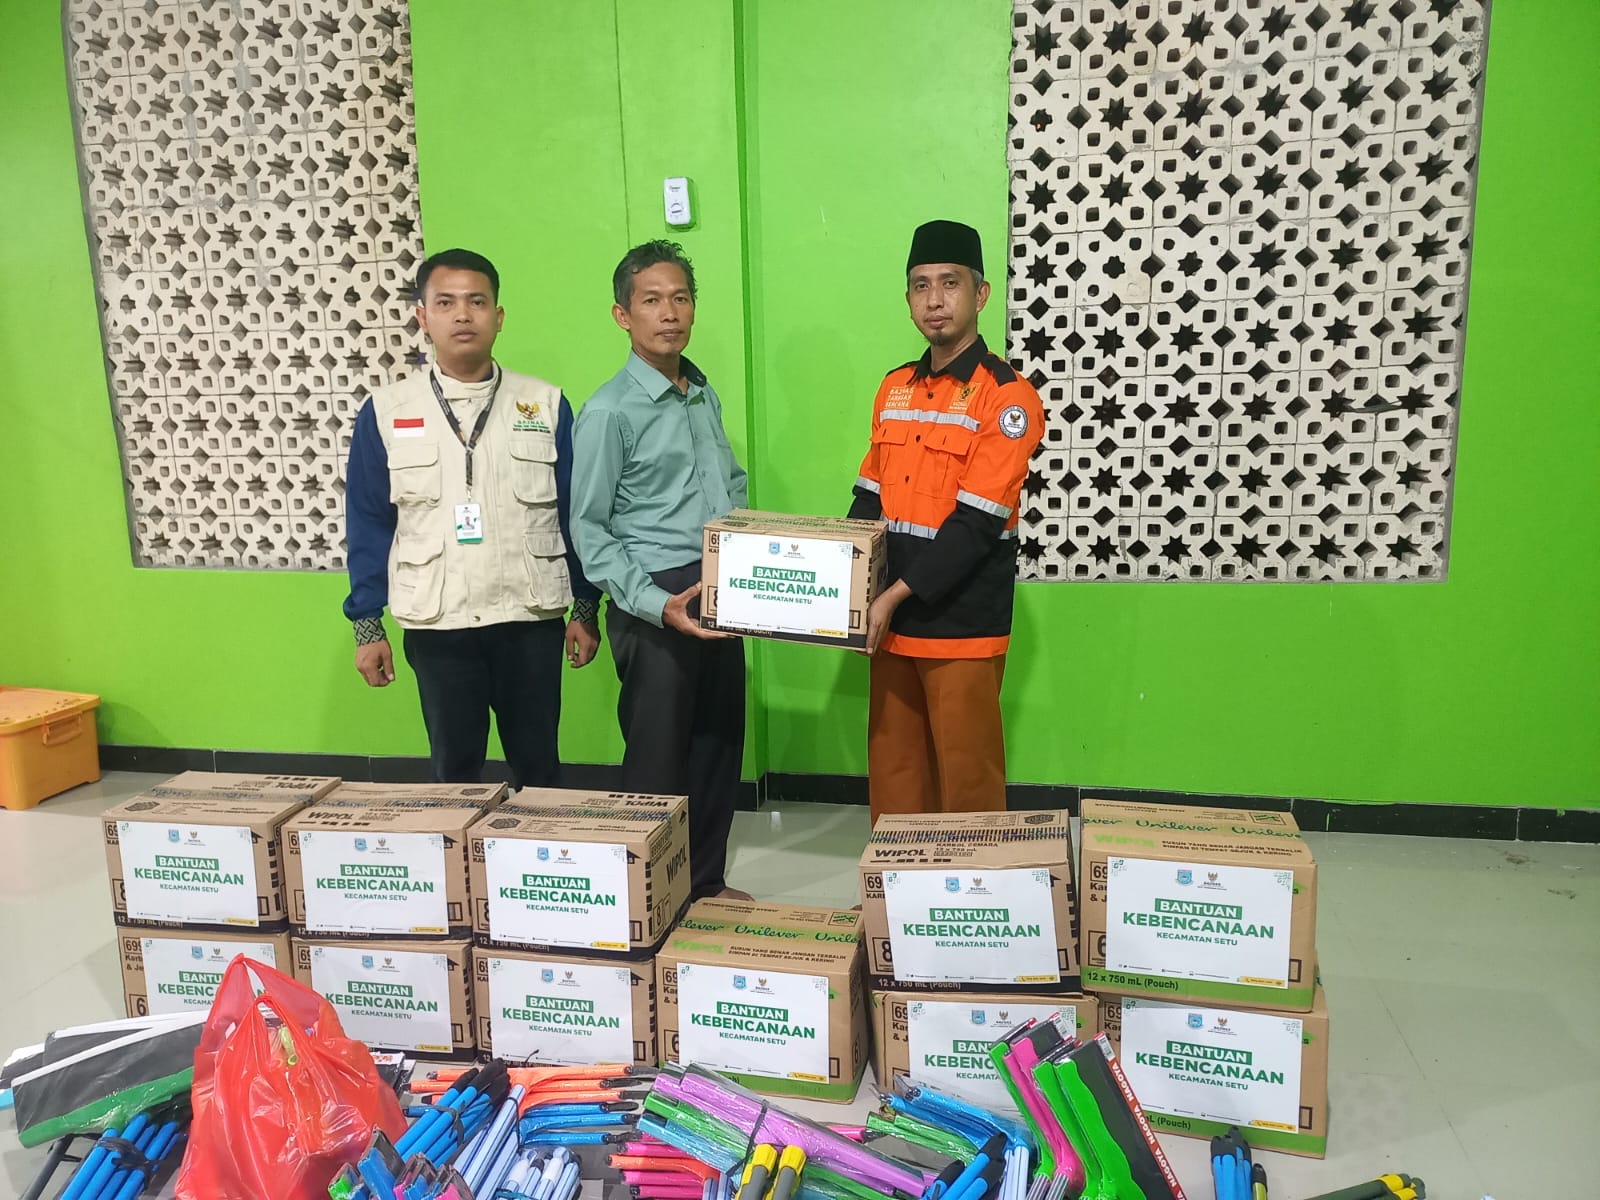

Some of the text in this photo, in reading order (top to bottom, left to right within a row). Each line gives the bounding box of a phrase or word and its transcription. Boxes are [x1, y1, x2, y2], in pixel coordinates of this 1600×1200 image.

[756, 568, 812, 582] BANTUAN
[729, 577, 839, 598] KEBENCANAAN
[753, 594, 794, 603] KECAMATAN
[1136, 820, 1217, 832] Unilever
[875, 849, 927, 857] WIPOL
[159, 857, 215, 869] BANTUAN
[134, 868, 244, 885] KEBENCANAAN
[344, 866, 404, 877] BANTUAN
[160, 883, 200, 891] KECAMATAN
[316, 878, 434, 893] KEBENCANAAN
[527, 877, 586, 888] BANTUAN
[500, 887, 616, 906] KEBENCANAAN
[526, 904, 570, 913] KECAMATAN
[935, 910, 1005, 921] BANTUAN
[1160, 900, 1237, 918] BANTUAN
[735, 925, 803, 938] Unilever
[904, 924, 1040, 937] KEBENCANAAN
[1123, 912, 1274, 938] KEBENCANAAN
[1156, 932, 1238, 946] KECAMATAN SETU
[182, 973, 222, 984] BANTU
[1087, 972, 1098, 981] 12
[1109, 974, 1126, 984] 750
[1128, 976, 1142, 986] mL
[1144, 977, 1179, 990] (Pouch)
[158, 984, 214, 997] KEBENC
[352, 983, 409, 996] BANTUAN
[325, 993, 438, 1012] KEBENCANAAN
[530, 998, 590, 1010] BANTUAN
[352, 1010, 393, 1018] KECAMATAN
[502, 1008, 620, 1028] KEBENCANAAN
[721, 1004, 784, 1020] BANTUAN
[529, 1025, 572, 1035] KECAMATAN
[691, 1013, 815, 1039] KEBENCANAAN
[719, 1032, 786, 1046] KECAMATAN SETU
[1172, 1043, 1247, 1063] BANTUAN
[924, 1054, 995, 1069] KEBENC
[1136, 1052, 1284, 1085] KEBENCANAAN
[956, 1072, 1000, 1080] KECAMATA
[1112, 1062, 1134, 1102] NAGOYA
[1169, 1073, 1248, 1090] KECAMATAN SETU
[1134, 1105, 1155, 1145] NAGOYA
[1157, 1116, 1190, 1130] (Pouch)
[1155, 1147, 1176, 1187] NAGOYA
